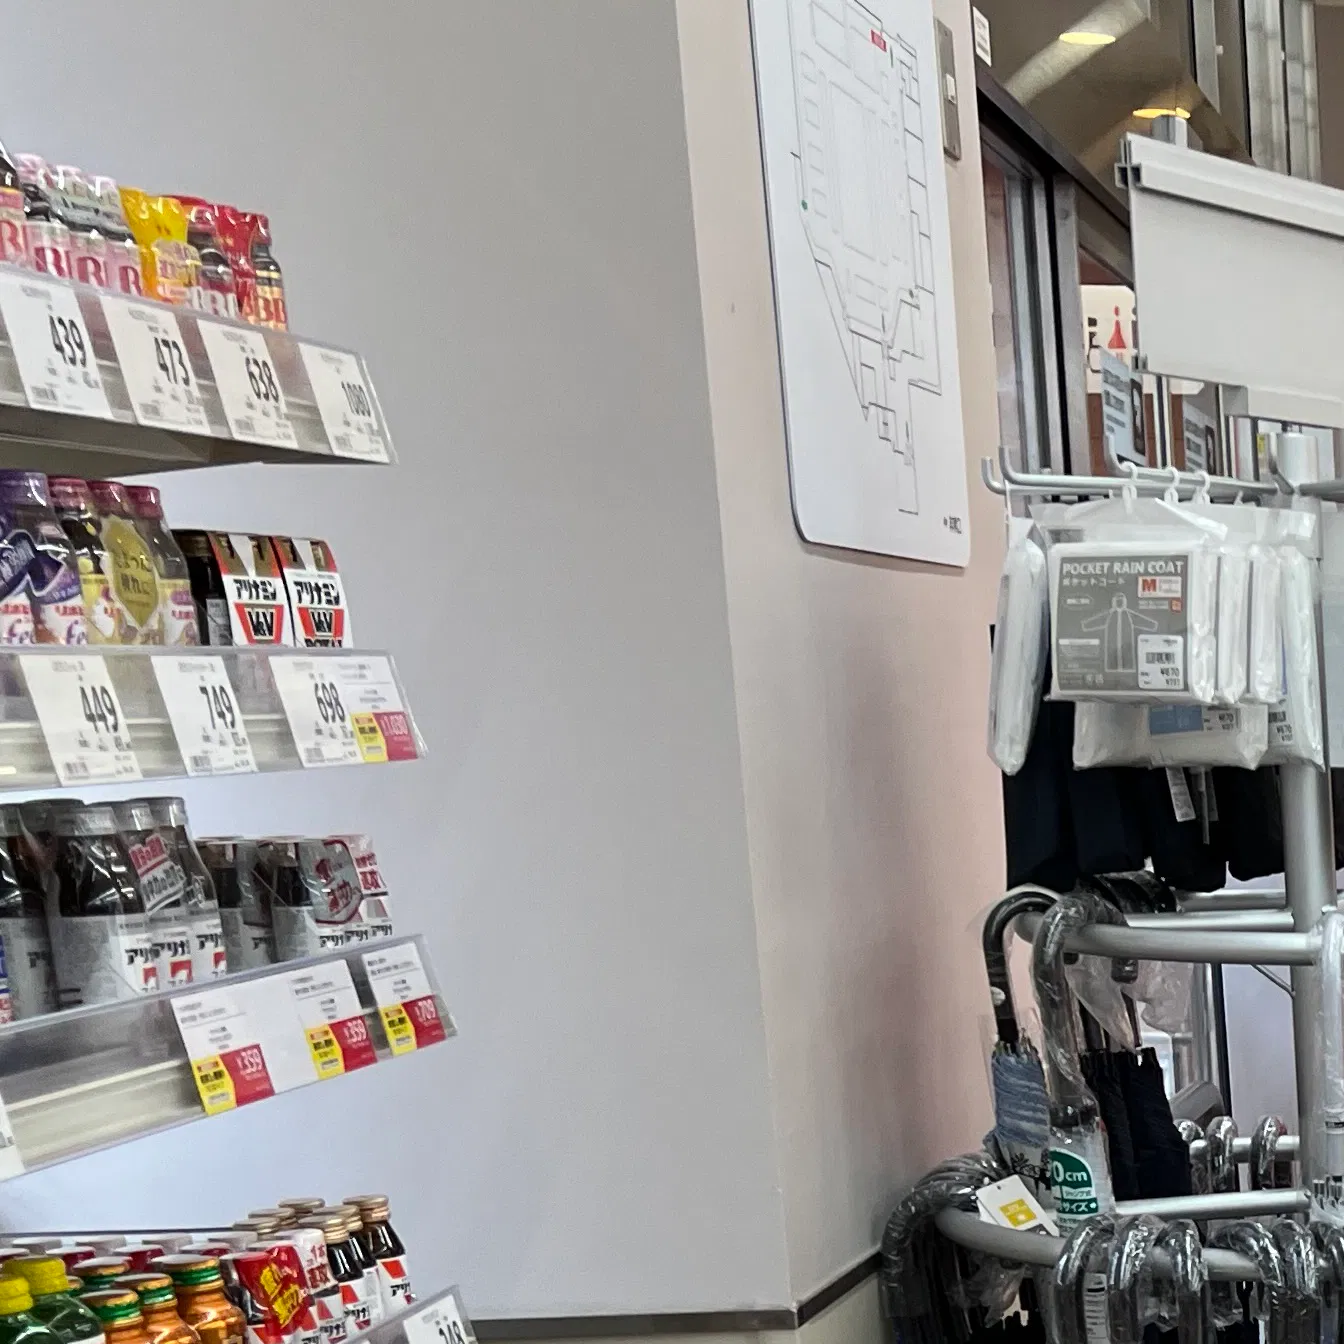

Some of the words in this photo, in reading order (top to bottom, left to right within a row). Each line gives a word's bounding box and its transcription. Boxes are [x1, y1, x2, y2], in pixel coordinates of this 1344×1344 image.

[49, 315, 88, 369] 439
[154, 336, 191, 388] 473
[245, 357, 280, 402] 638
[1062, 561, 1111, 576] POCKET
[1113, 561, 1145, 576] RAIN
[1147, 560, 1184, 575] COAT
[1140, 578, 1158, 592] M
[78, 685, 119, 734] 449
[197, 685, 236, 730] 749
[313, 680, 347, 724] 698
